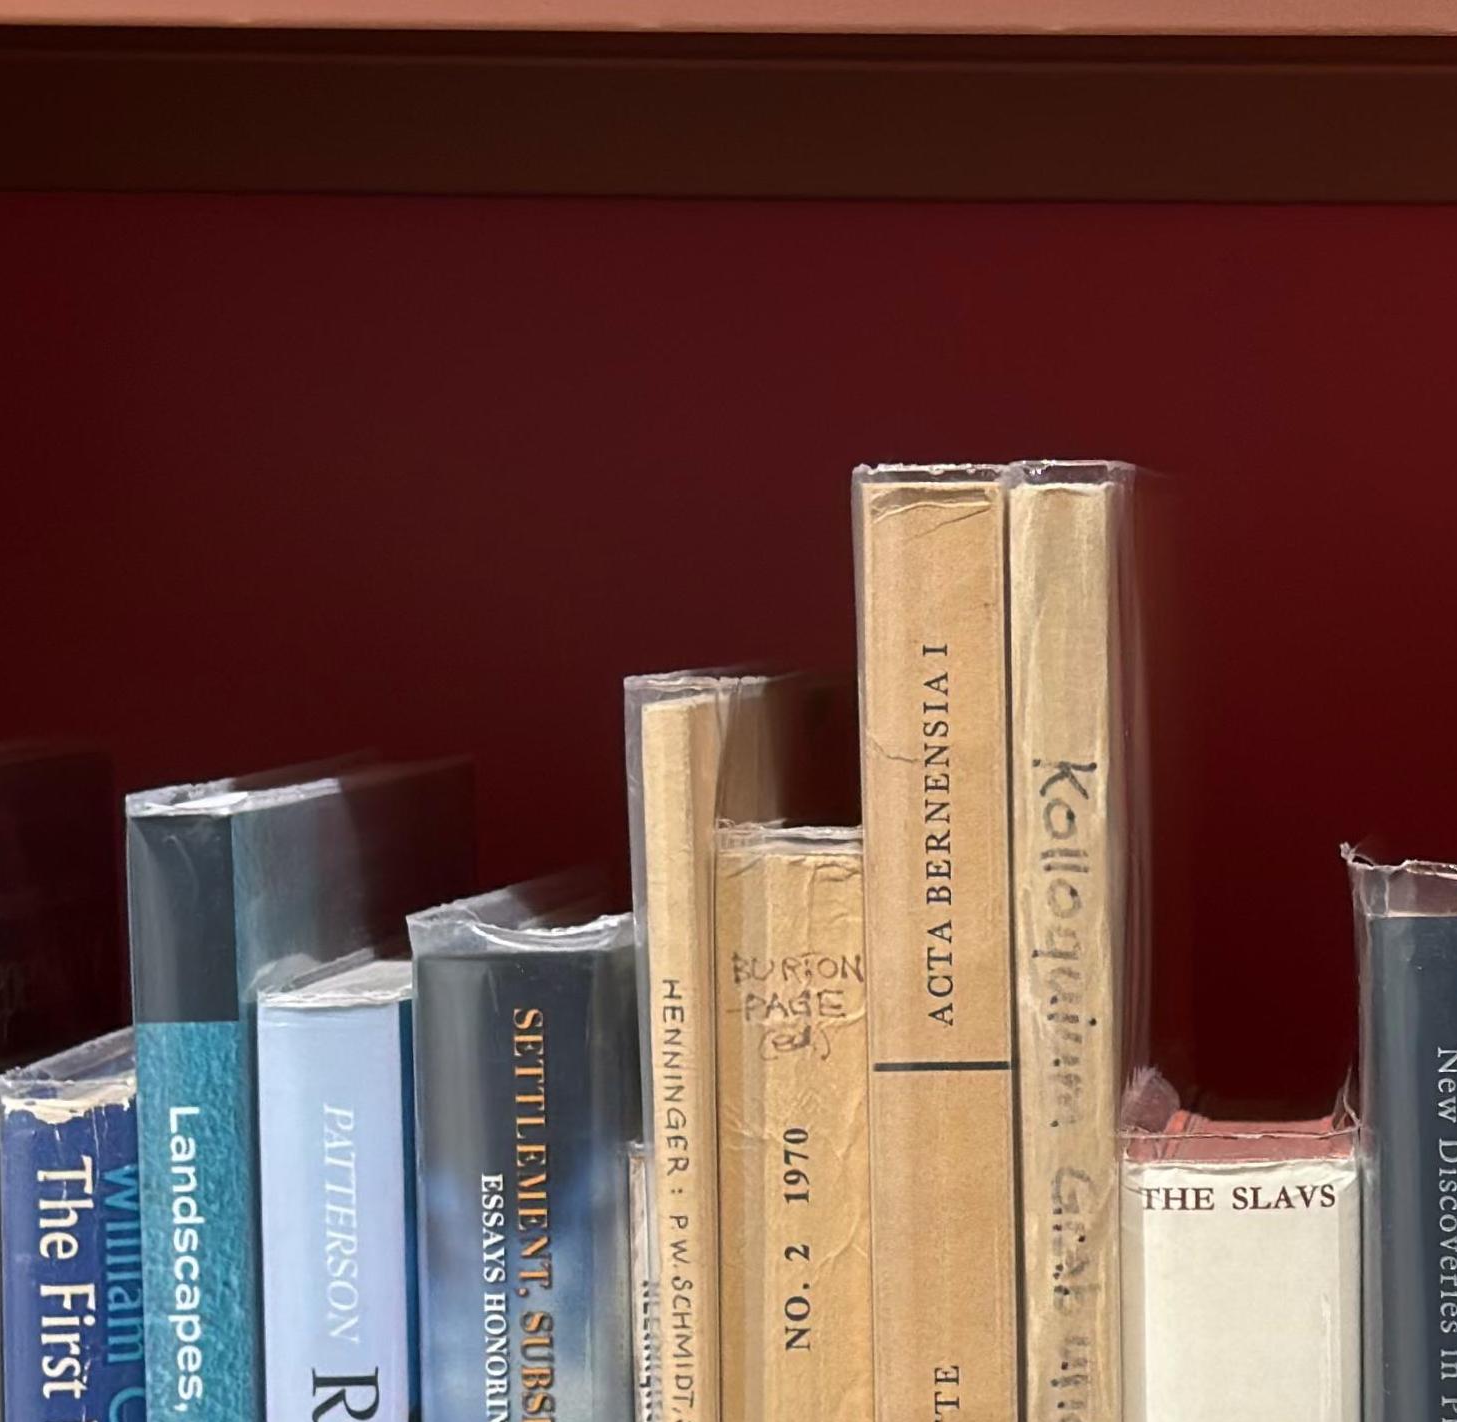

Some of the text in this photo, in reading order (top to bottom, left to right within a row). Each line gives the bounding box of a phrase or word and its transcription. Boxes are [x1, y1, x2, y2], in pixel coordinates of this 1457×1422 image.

[922, 643, 954, 1028] ACTA BERNENSIA I
[512, 1007, 554, 1298] SETTLEMENT,
[782, 1126, 811, 1205] 1970
[1141, 1183, 1337, 1212] THE SLAVS
[167, 1106, 207, 1412] Landscapes,
[322, 1103, 360, 1345] PATTERSON
[480, 1172, 507, 1284] ESSAYS
[784, 1243, 811, 1262] 2
[785, 1283, 812, 1351] NO.
